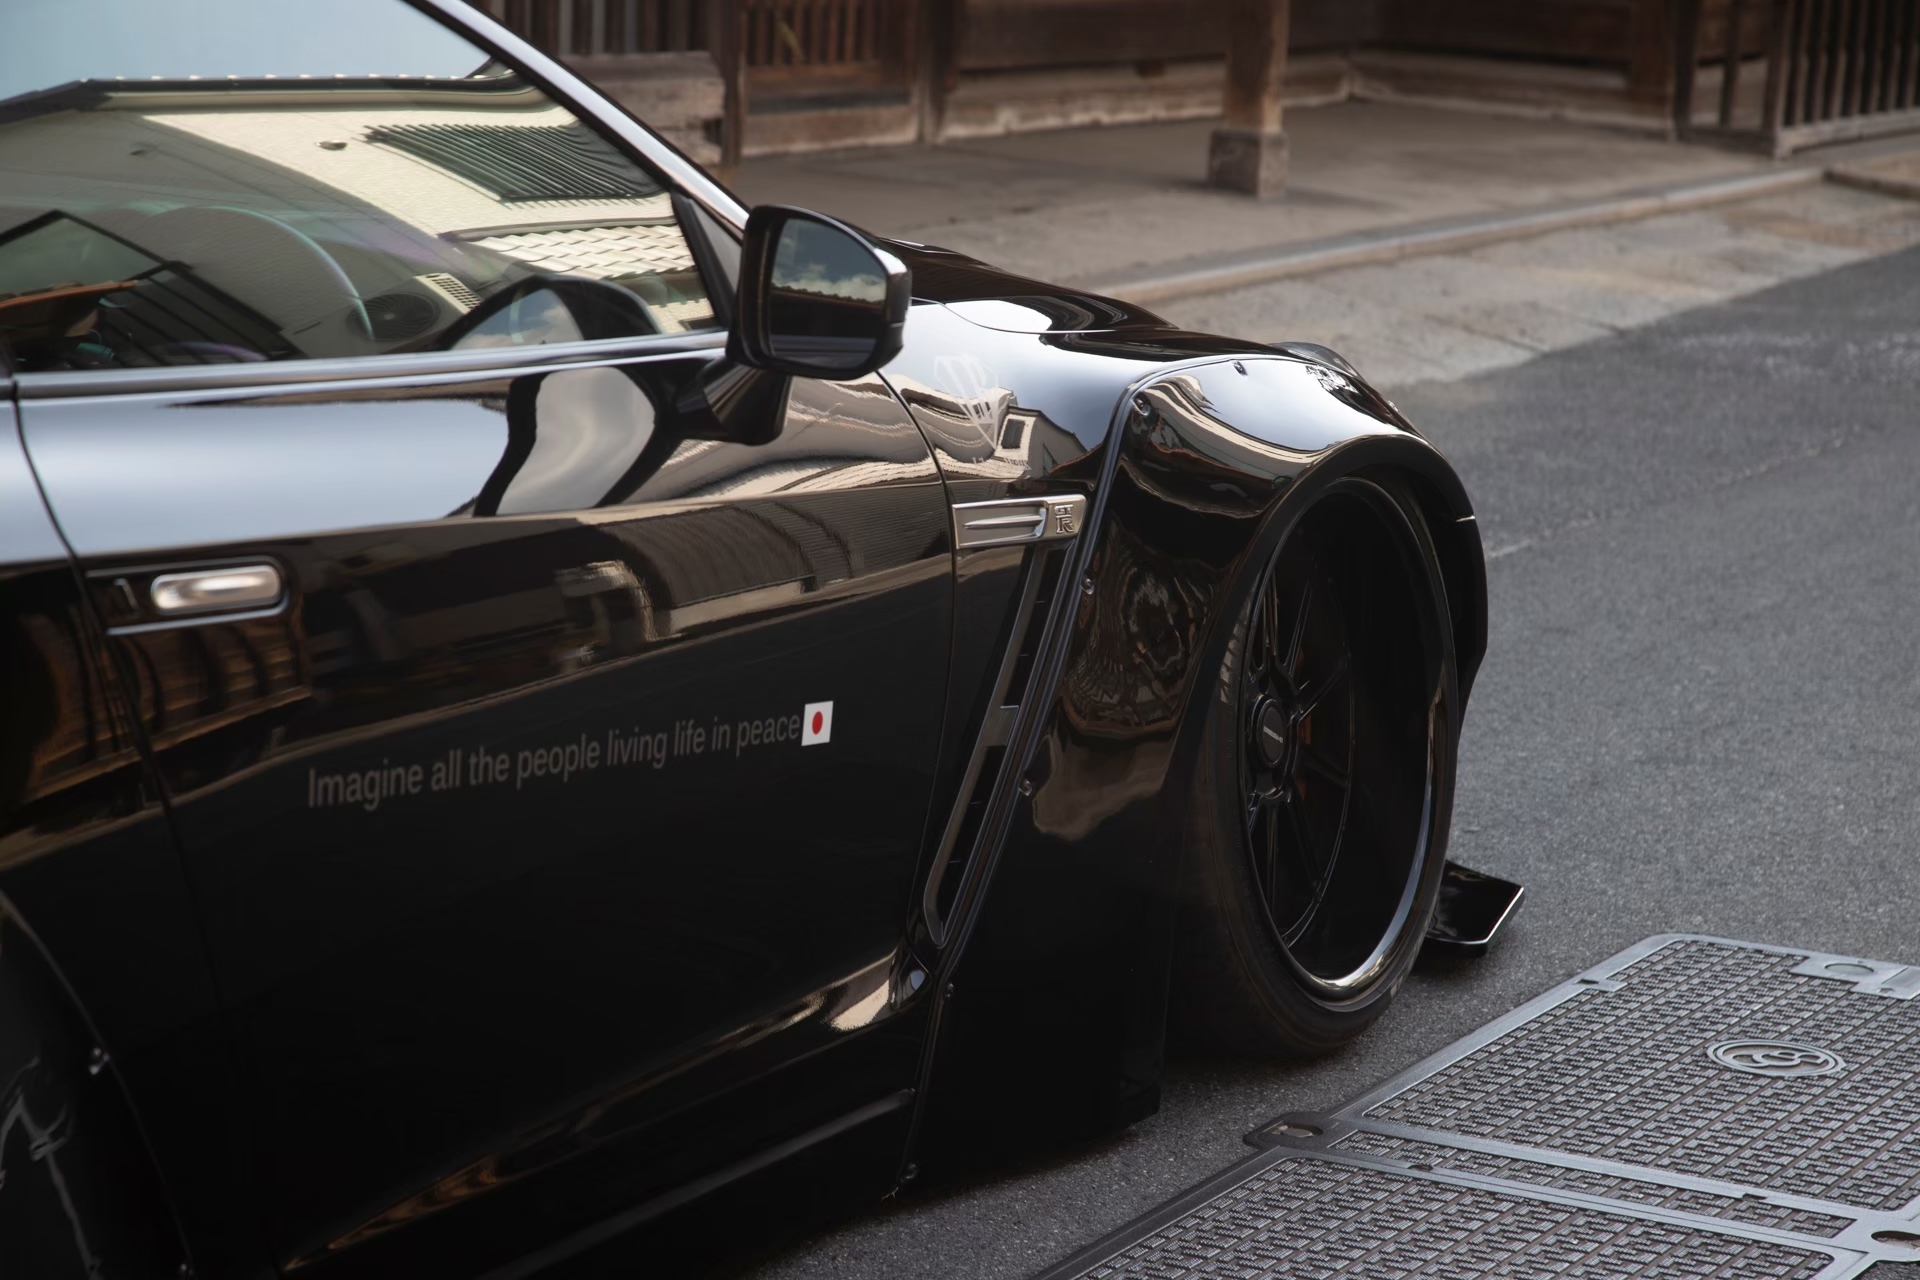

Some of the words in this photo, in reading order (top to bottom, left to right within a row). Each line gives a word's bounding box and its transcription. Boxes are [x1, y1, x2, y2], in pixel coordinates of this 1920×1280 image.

[308, 756, 424, 812] Imagine
[430, 748, 462, 791] all
[468, 745, 510, 787] the
[516, 732, 601, 790] people
[606, 726, 668, 769] living
[673, 718, 706, 757] life
[711, 715, 731, 751] in
[736, 713, 801, 760] peace
